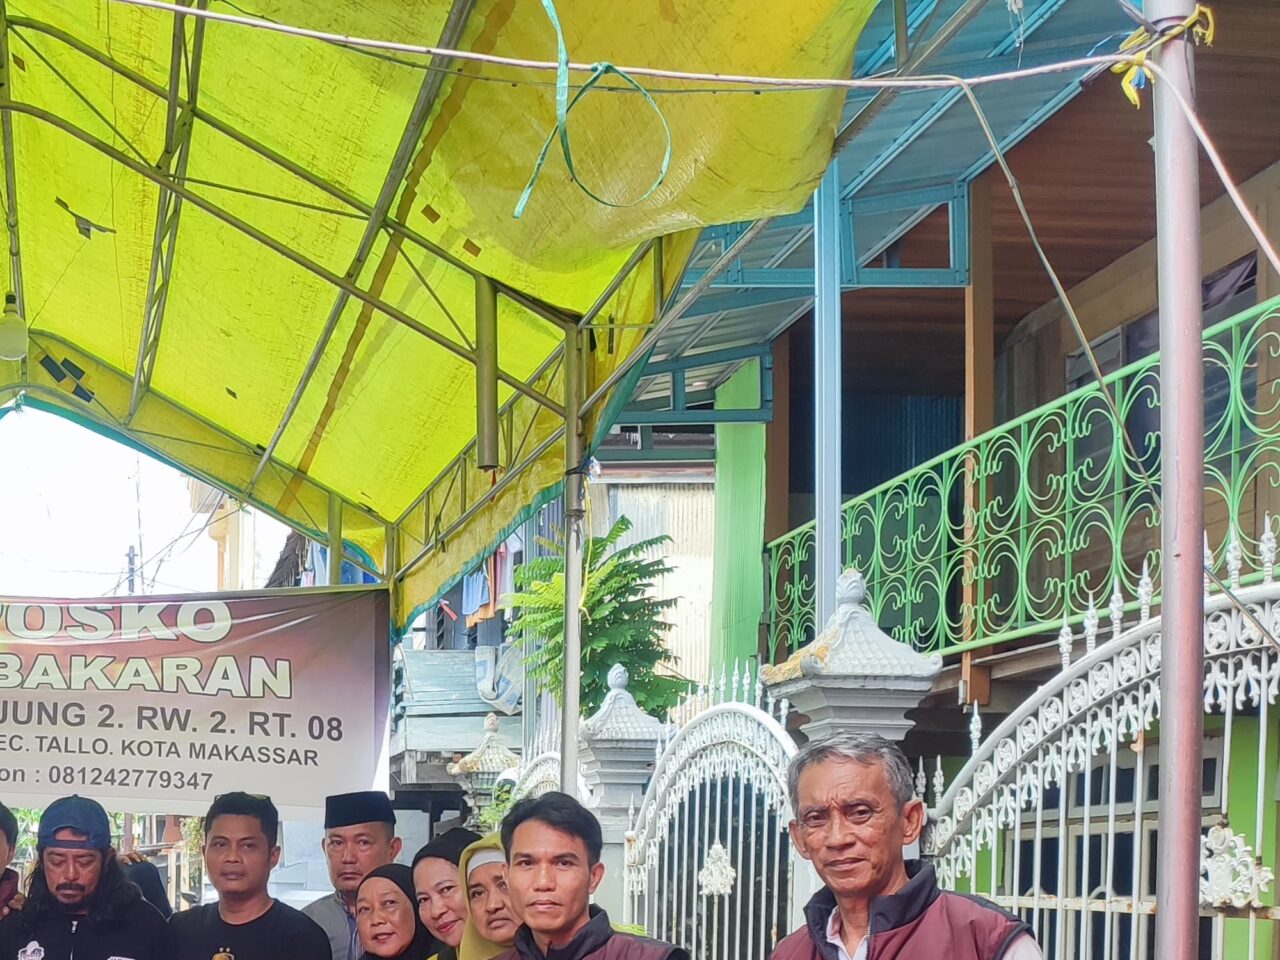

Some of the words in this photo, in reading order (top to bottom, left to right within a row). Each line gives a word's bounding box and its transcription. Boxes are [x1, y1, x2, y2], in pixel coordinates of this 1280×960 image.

[97, 704, 124, 729] 2.
[137, 705, 197, 733] RW.
[210, 710, 236, 734] 2.
[249, 711, 297, 738] RT.
[308, 715, 344, 742] 08
[35, 736, 114, 757] TALLO.
[122, 739, 181, 760] KOTA
[189, 743, 320, 768] MAKASSAR
[49, 765, 214, 791] 081242779347
